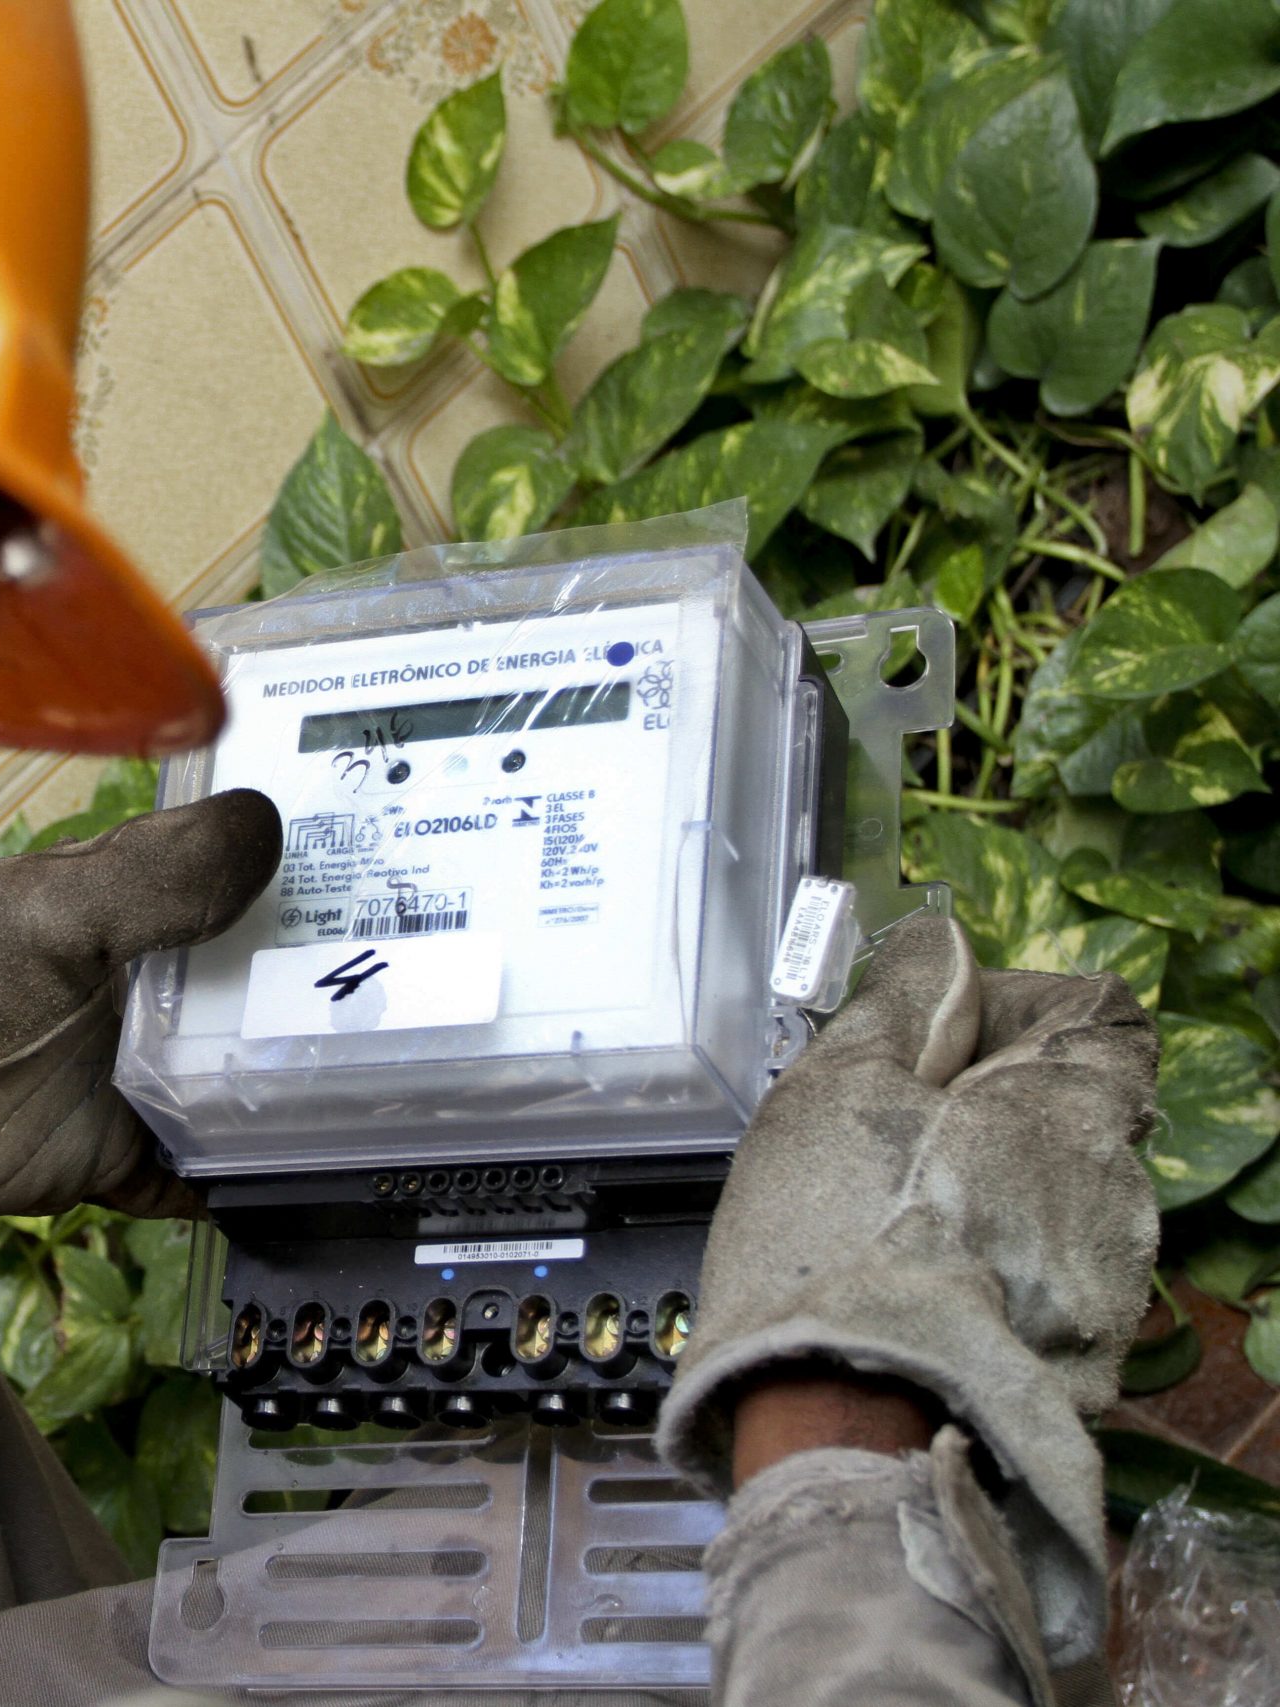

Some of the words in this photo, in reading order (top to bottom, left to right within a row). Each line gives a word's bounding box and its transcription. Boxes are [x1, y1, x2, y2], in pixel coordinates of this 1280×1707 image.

[263, 676, 345, 698] MEDIDOR
[351, 663, 462, 689] ELETRÔNICO
[467, 658, 490, 675] DE
[497, 649, 576, 671] ENERGIA
[585, 639, 663, 663] ELÉICA
[643, 713, 671, 731] EL
[546, 790, 585, 803] CLASSE
[588, 789, 596, 799] B
[554, 803, 565, 813] EL
[552, 812, 585, 824] FASES
[552, 823, 577, 834] FIOS
[321, 872, 362, 884] Energia
[305, 908, 342, 926] Light
[314, 949, 389, 1002] 4
